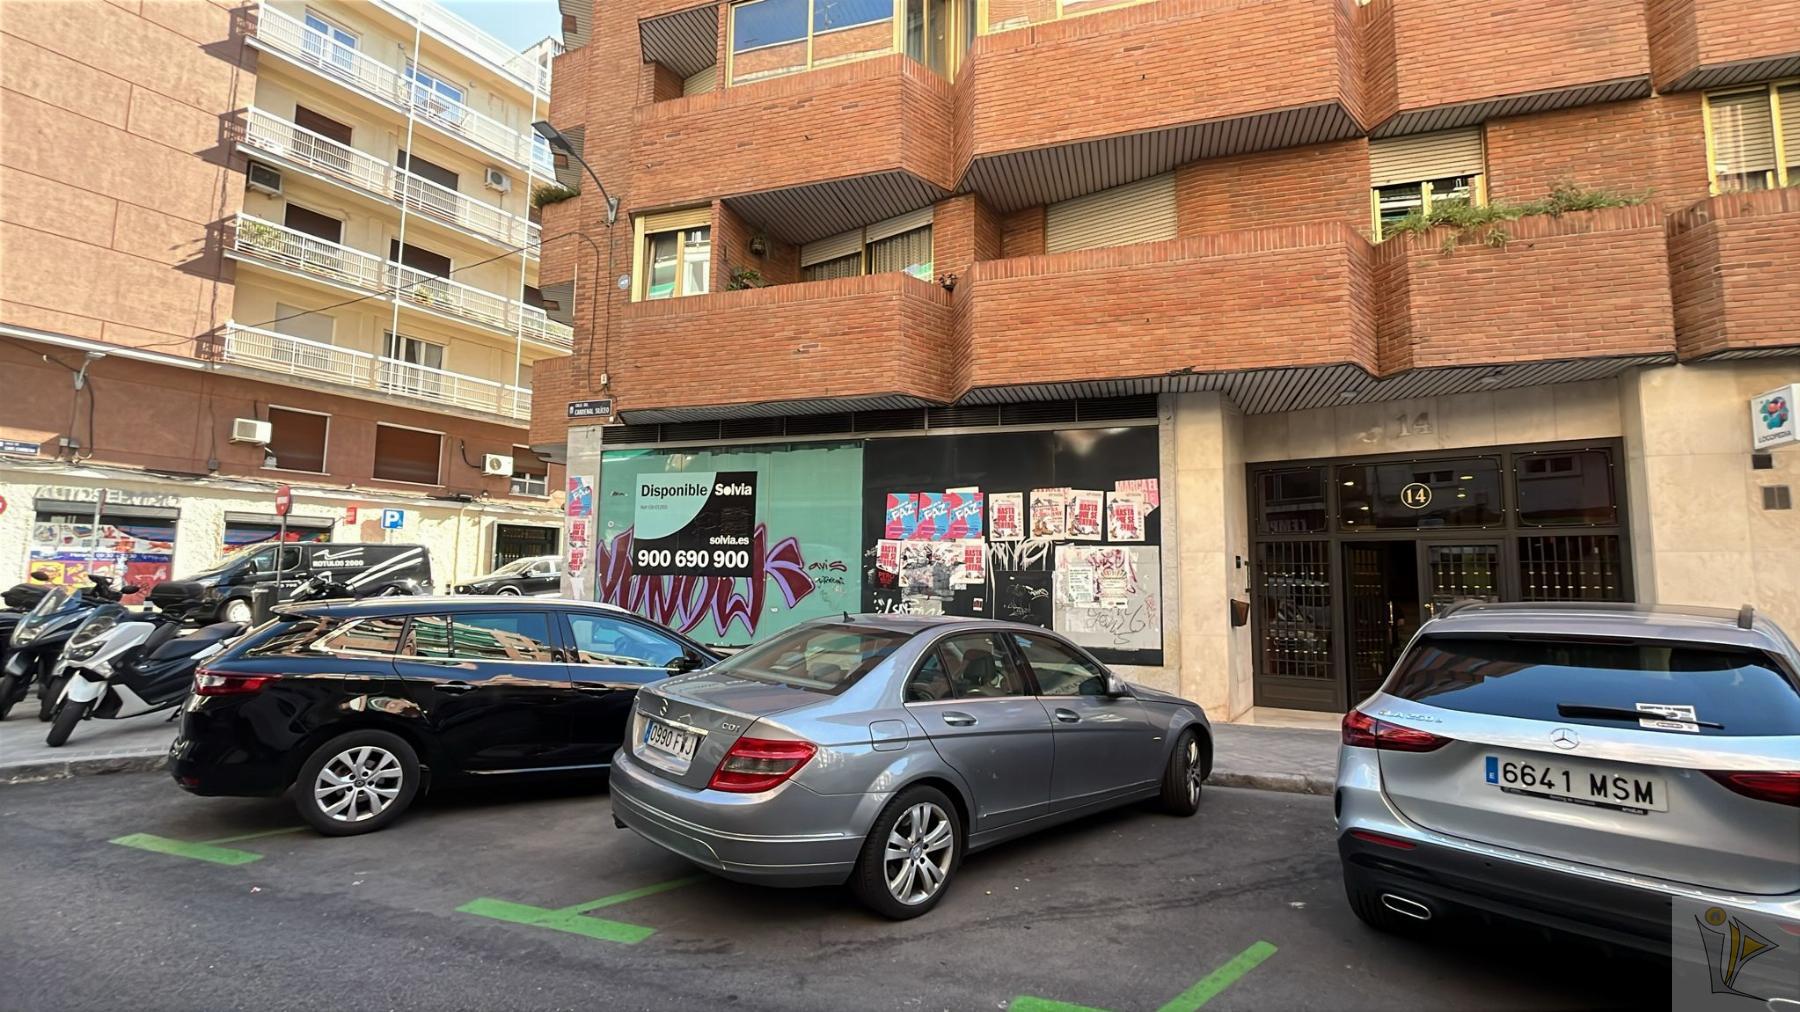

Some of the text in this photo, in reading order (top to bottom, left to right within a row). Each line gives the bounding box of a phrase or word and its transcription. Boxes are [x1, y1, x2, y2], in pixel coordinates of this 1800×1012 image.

[641, 484, 708, 499] Disponible
[714, 483, 753, 496] Solvia
[1406, 487, 1427, 504] 14
[385, 511, 399, 525] P
[709, 535, 750, 545] solvia.es
[637, 549, 749, 568] 900 690 900
[650, 725, 673, 747] 0990
[1502, 762, 1654, 805] 6641 MSM
